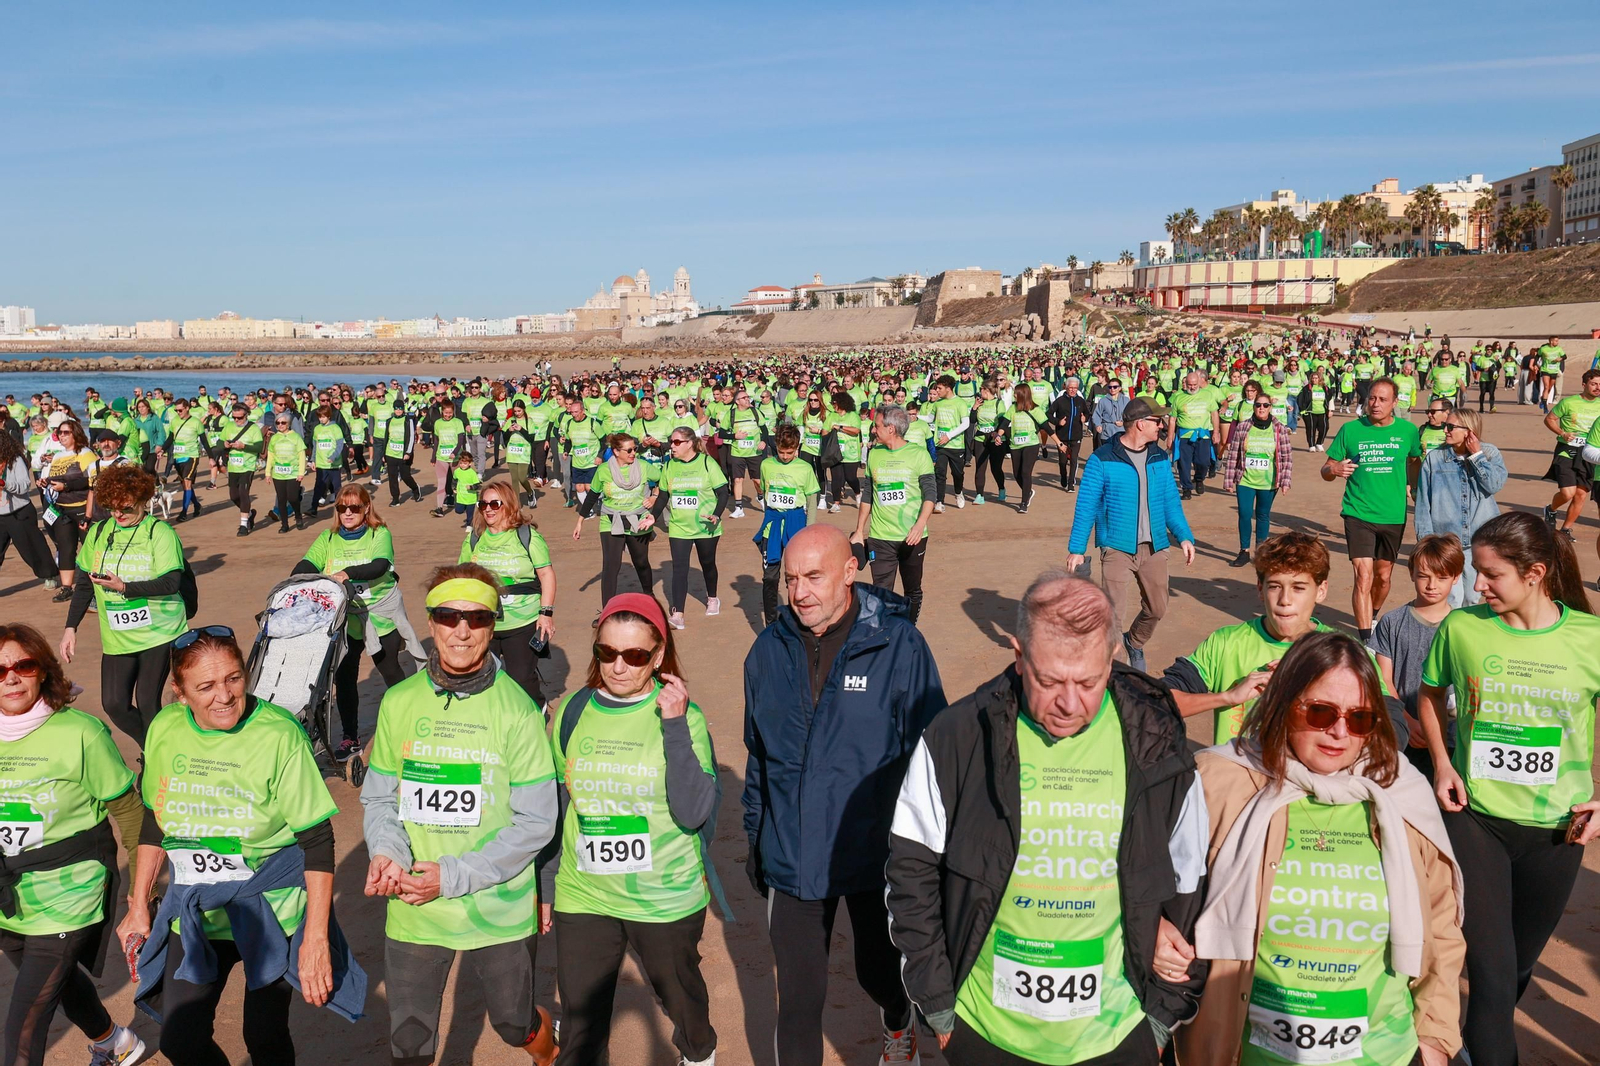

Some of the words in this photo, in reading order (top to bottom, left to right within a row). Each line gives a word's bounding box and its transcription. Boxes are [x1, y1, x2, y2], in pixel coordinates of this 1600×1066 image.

[1358, 449, 1385, 457] contra
[1249, 458, 1269, 467] 2113
[676, 497, 698, 506] 2160
[771, 494, 795, 505] 3386
[881, 490, 905, 502] 3383
[113, 609, 149, 625] 1932
[1507, 658, 1540, 668] asociación
[1540, 662, 1568, 671] española
[1533, 666, 1555, 675] cáncer
[1515, 670, 1532, 679] Cádiz
[1482, 677, 1506, 694] En
[1510, 681, 1580, 703] marcha
[1480, 700, 1553, 718] contra
[434, 719, 463, 728] asociación
[463, 722, 488, 731] española
[457, 727, 476, 735] cáncer
[1501, 724, 1524, 732] marcha
[622, 740, 644, 748] española
[412, 740, 432, 757] En
[435, 744, 500, 765] marcha
[190, 757, 216, 765] asociación
[216, 760, 242, 769] española
[1488, 746, 1555, 774] 3388
[195, 769, 209, 777] Cádiz
[210, 765, 229, 773] cáncer
[574, 757, 593, 772] En
[596, 761, 659, 778] marcha
[1042, 766, 1081, 775] asociación
[1081, 768, 1114, 777] española
[1067, 775, 1074, 783] el
[1075, 776, 1100, 784] cáncer
[168, 777, 188, 793] En
[190, 783, 256, 800] marcha
[572, 778, 633, 796] contra
[635, 781, 656, 797] el
[1053, 782, 1073, 791] Cádiz
[36, 786, 58, 805] el
[414, 787, 477, 813] 1429
[165, 800, 230, 819] contra
[232, 802, 256, 820] el
[574, 793, 656, 816] cáncer
[1049, 799, 1123, 820] march
[163, 816, 256, 839] cáncer
[454, 827, 471, 835] Motor
[1299, 829, 1342, 838] asociación
[1108, 832, 1122, 849] e
[1336, 838, 1363, 846] cáncer
[585, 838, 646, 863] 1590
[192, 853, 238, 874] 935
[1012, 848, 1118, 880] cánce
[1269, 884, 1379, 912] contra
[1037, 899, 1096, 911] HYUNDAI
[1037, 911, 1074, 919] Guadalete
[1075, 911, 1096, 919] Motor
[1267, 908, 1389, 943] cánce
[1026, 940, 1055, 949] marcha
[1297, 972, 1337, 983] Guadalete
[1014, 969, 1098, 1004] 3849
[1287, 989, 1318, 999] marcha
